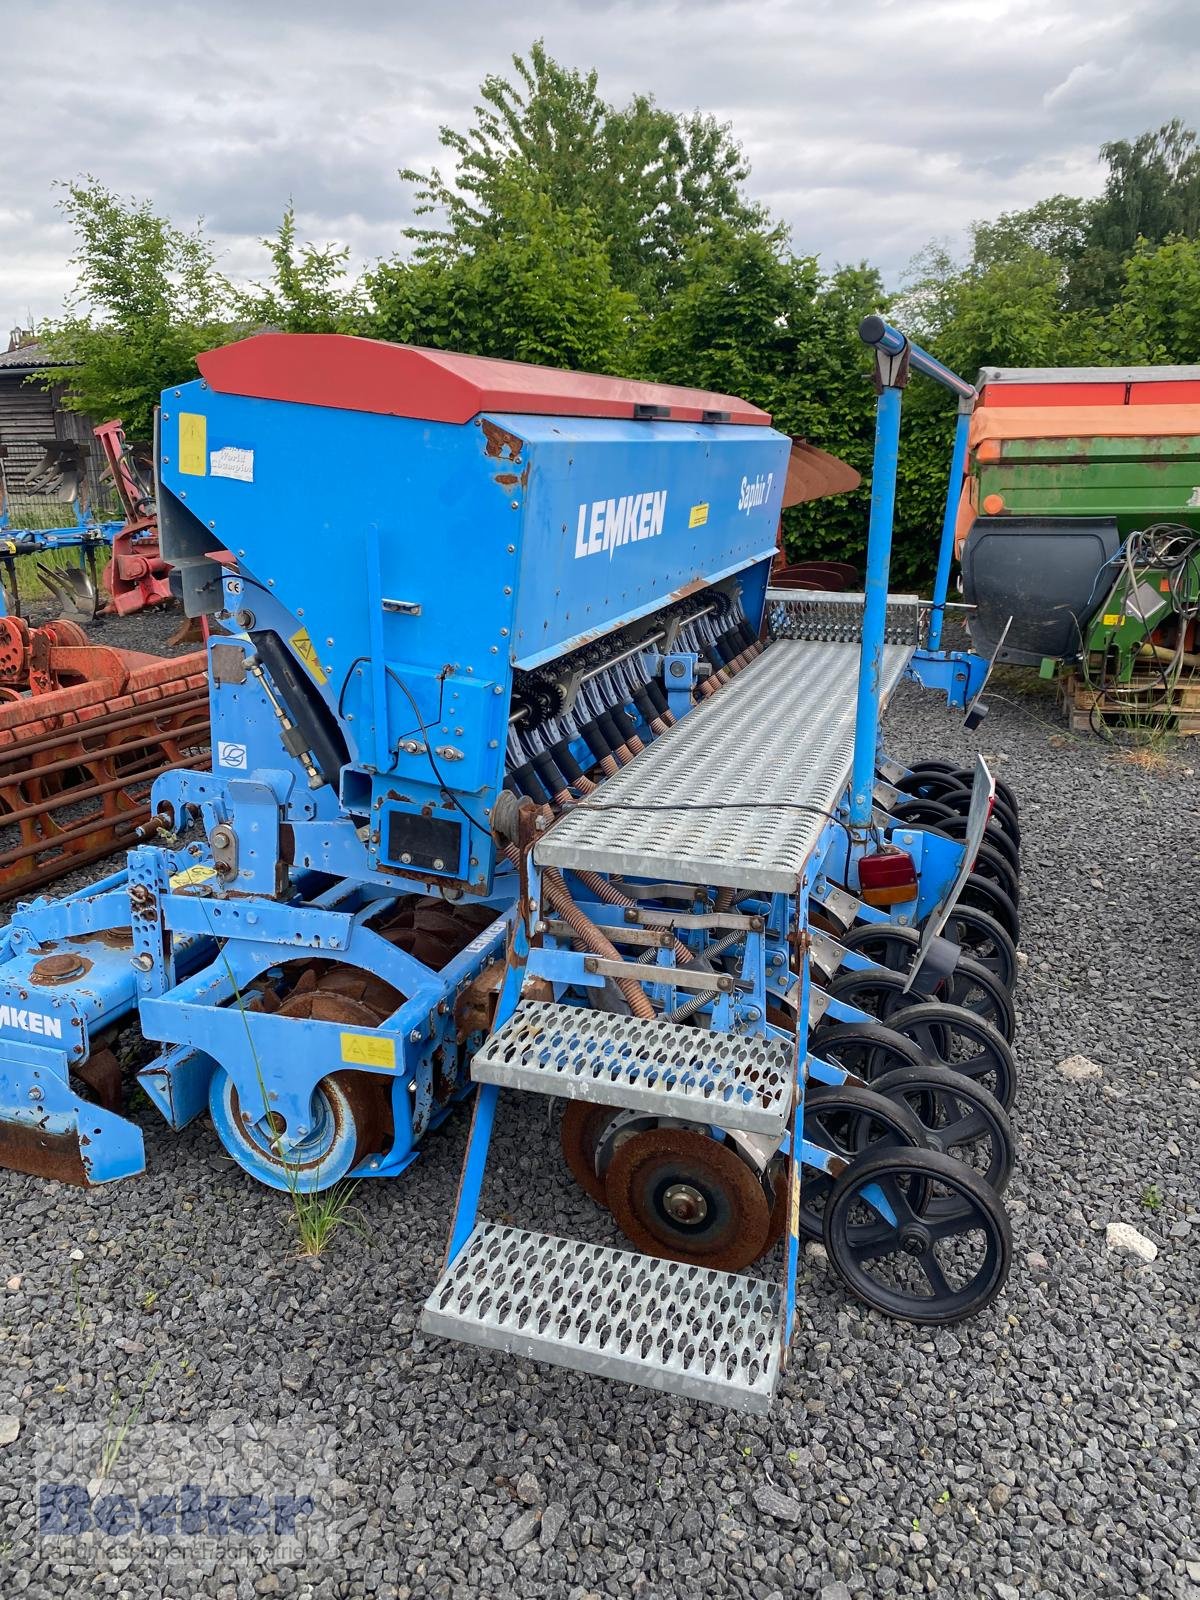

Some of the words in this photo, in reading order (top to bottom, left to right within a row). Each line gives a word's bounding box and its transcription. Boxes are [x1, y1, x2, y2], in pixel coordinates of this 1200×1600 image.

[738, 474, 765, 516] Saphir
[765, 472, 773, 504] 7
[574, 490, 667, 563] LEMKEN
[464, 921, 506, 952] LEMKEN
